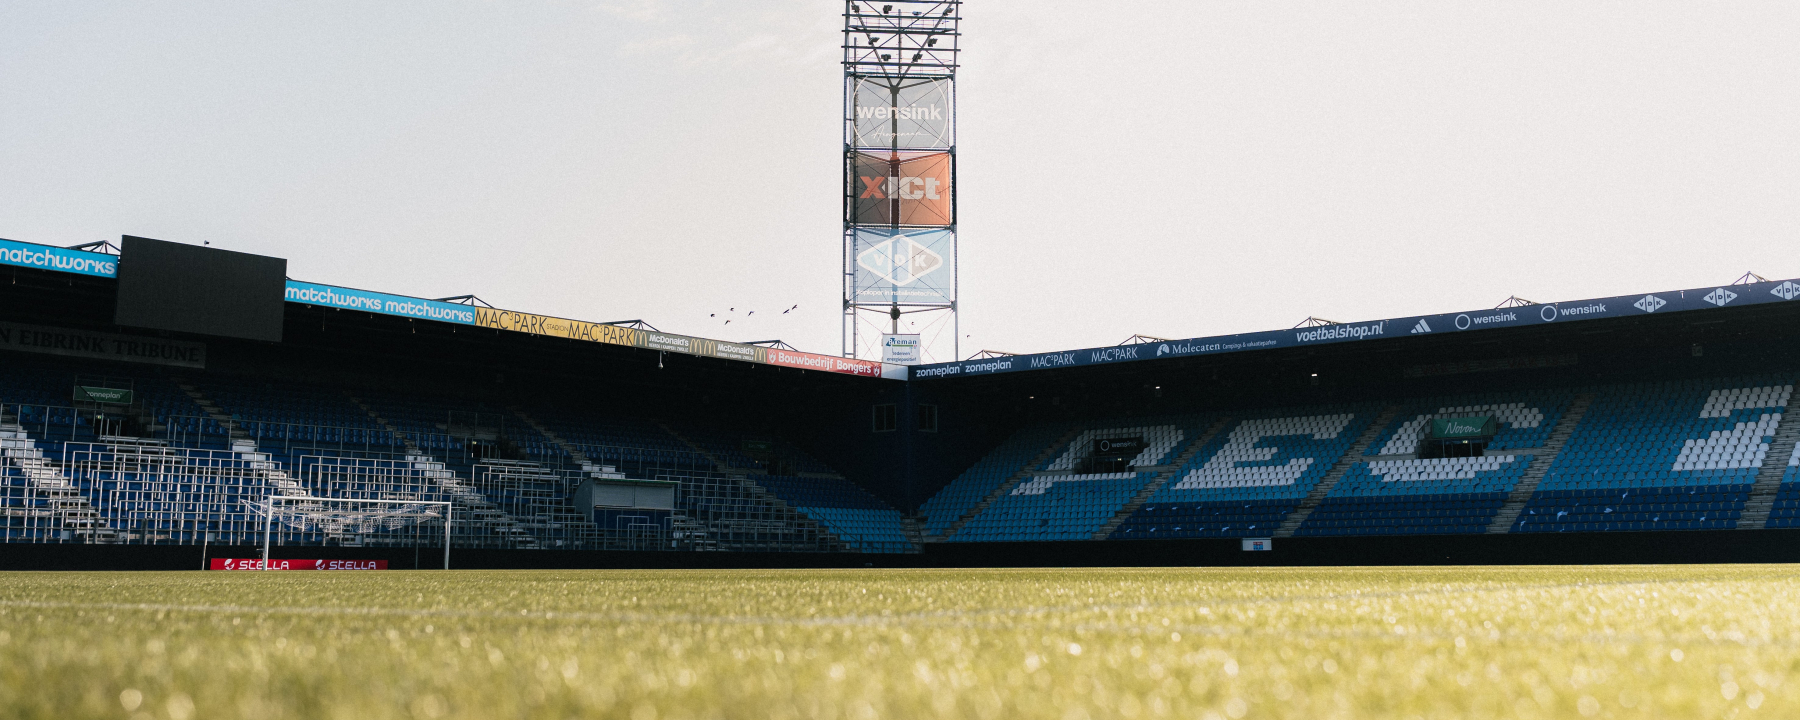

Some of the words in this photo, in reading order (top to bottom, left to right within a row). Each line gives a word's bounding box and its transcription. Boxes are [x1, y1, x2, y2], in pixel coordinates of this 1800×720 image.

[856, 104, 942, 120] wensink
[285, 286, 382, 310] matchworks
[386, 301, 474, 322] matchworks
[1473, 311, 1517, 325] wensink
[1560, 303, 1606, 317] wensink
[546, 323, 569, 332] STADION
[1296, 321, 1384, 343] voetbalshop.nl
[19, 330, 105, 354] EIBRINK
[113, 340, 199, 361] TRIBUNE
[1172, 342, 1221, 355] Molecaten
[778, 352, 834, 371] Bouwbedrijf
[837, 360, 872, 374] Bongers
[916, 365, 961, 378] zonneplan
[965, 361, 1013, 374] zonneplan
[1444, 421, 1482, 434] Novon
[329, 560, 376, 570] STELLA
